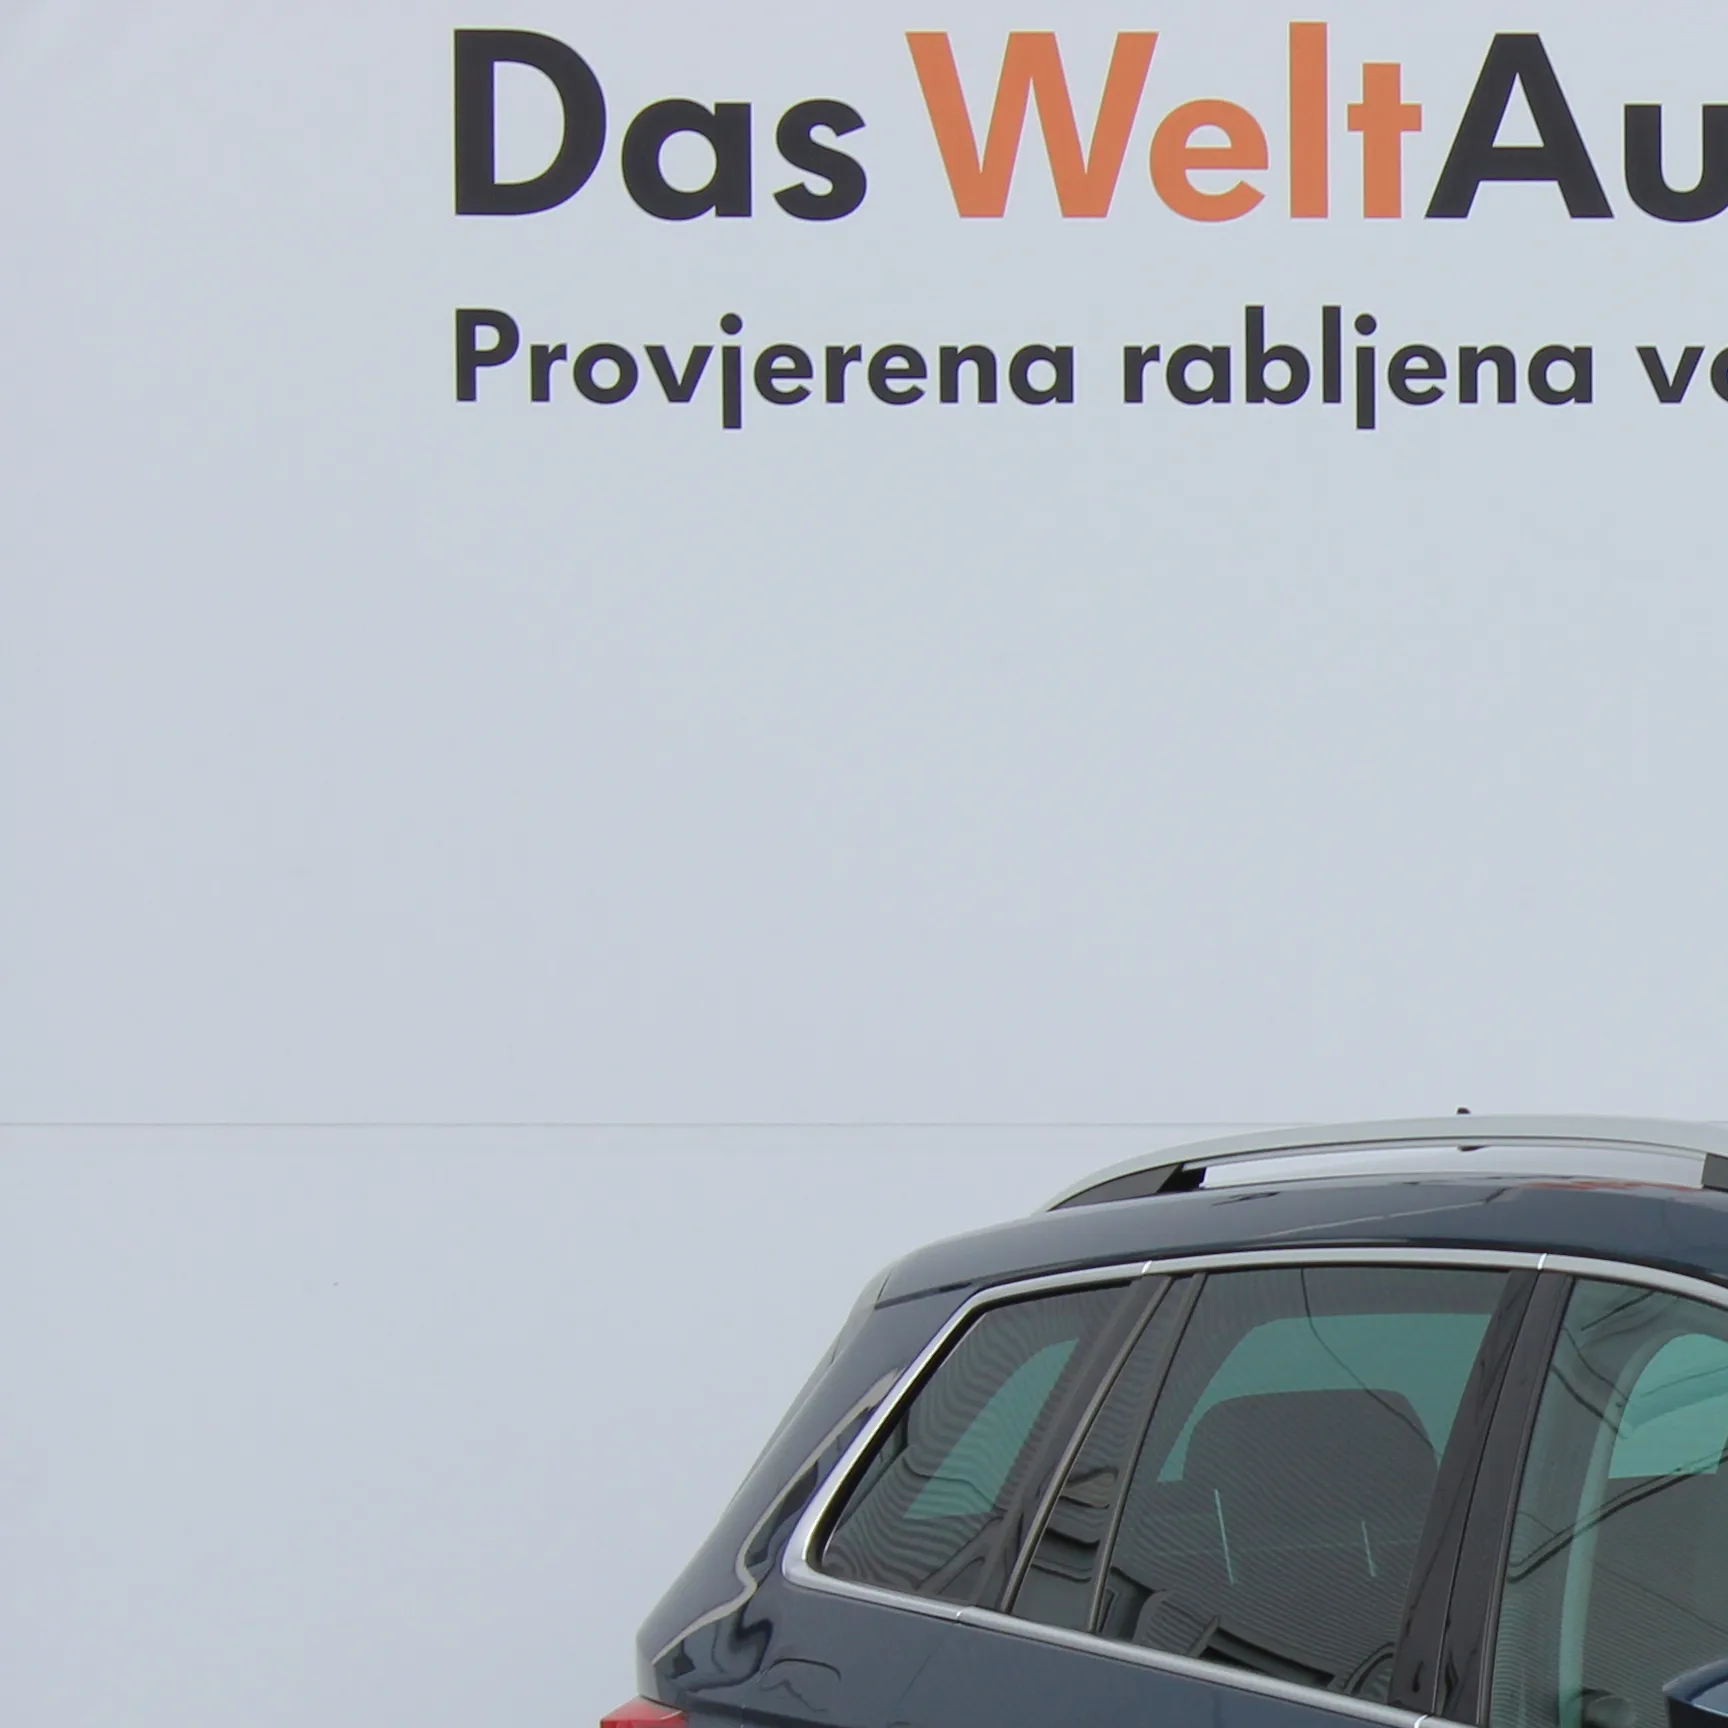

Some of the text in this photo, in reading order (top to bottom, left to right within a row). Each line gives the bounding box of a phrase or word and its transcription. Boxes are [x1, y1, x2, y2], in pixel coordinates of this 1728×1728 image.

[454, 29, 867, 221] Das
[454, 308, 1074, 429] Provjerena
[1124, 305, 1592, 430] rabljena
